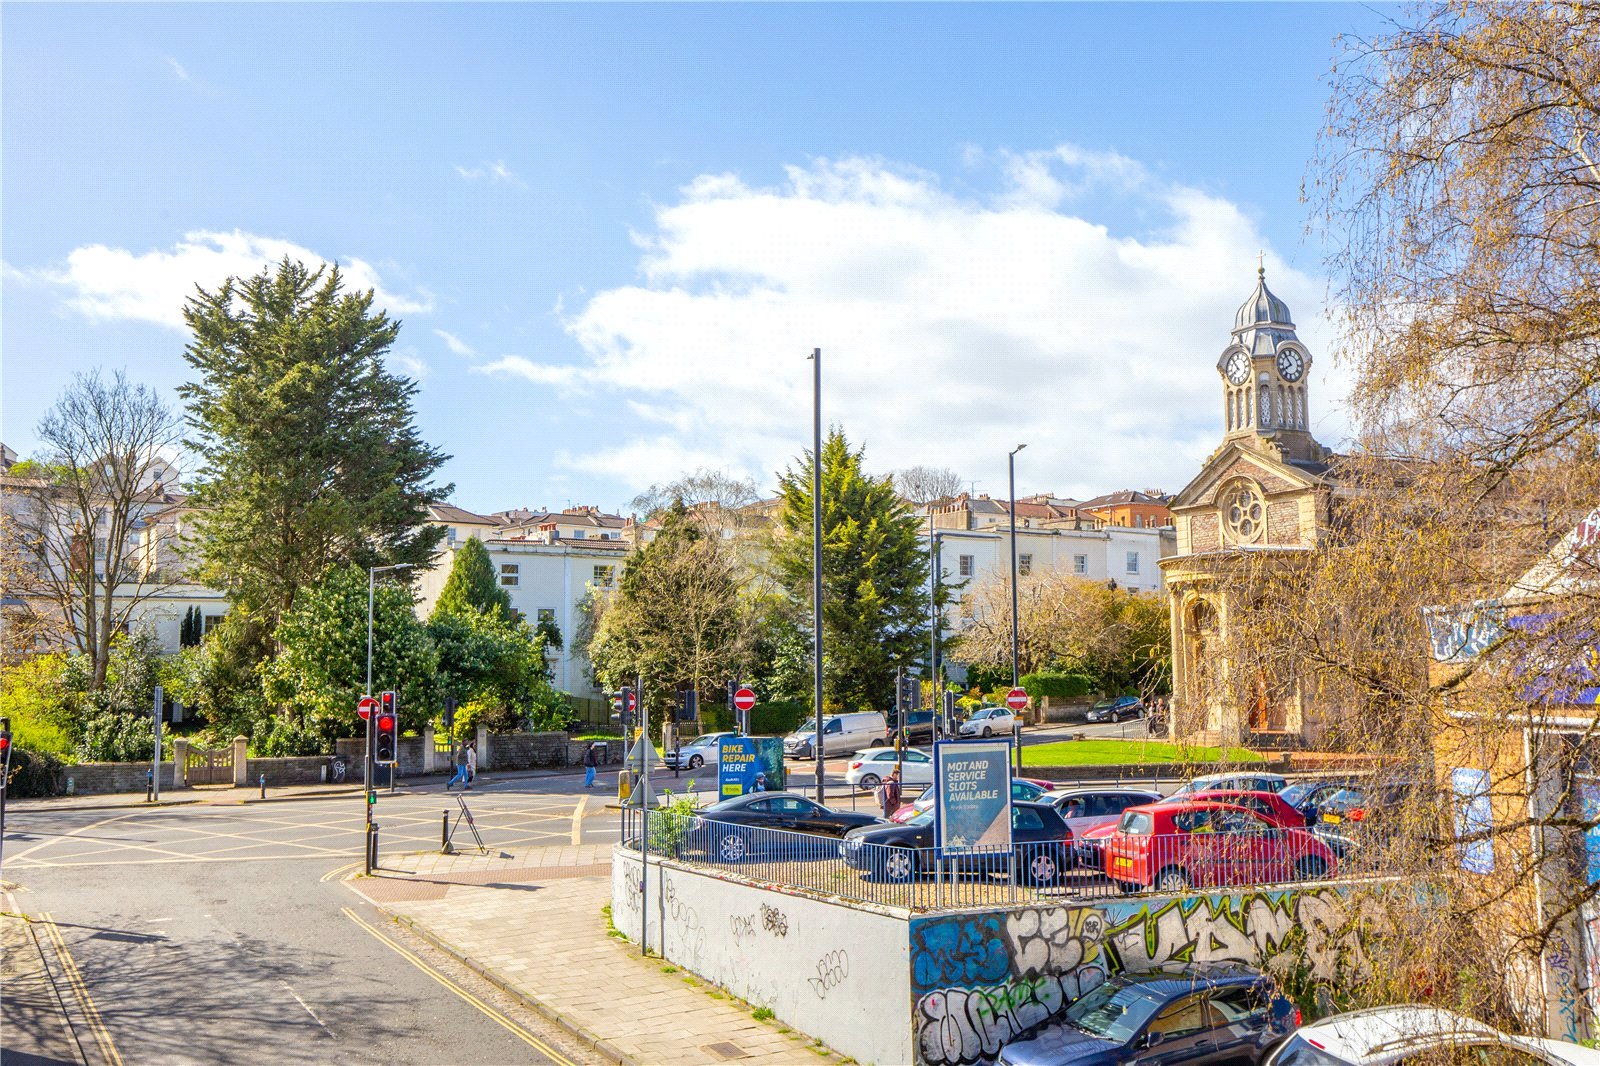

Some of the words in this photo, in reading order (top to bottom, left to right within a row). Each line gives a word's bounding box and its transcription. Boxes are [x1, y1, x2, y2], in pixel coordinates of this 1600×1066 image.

[722, 745, 743, 753] BIKE
[722, 754, 755, 762] REPAIR
[722, 764, 746, 772] HERE
[948, 762, 968, 772] MOT
[969, 760, 988, 770] AND
[948, 771, 986, 782] SERVICE
[948, 782, 977, 792] SLOTS
[949, 790, 998, 802] AVAILABLE
